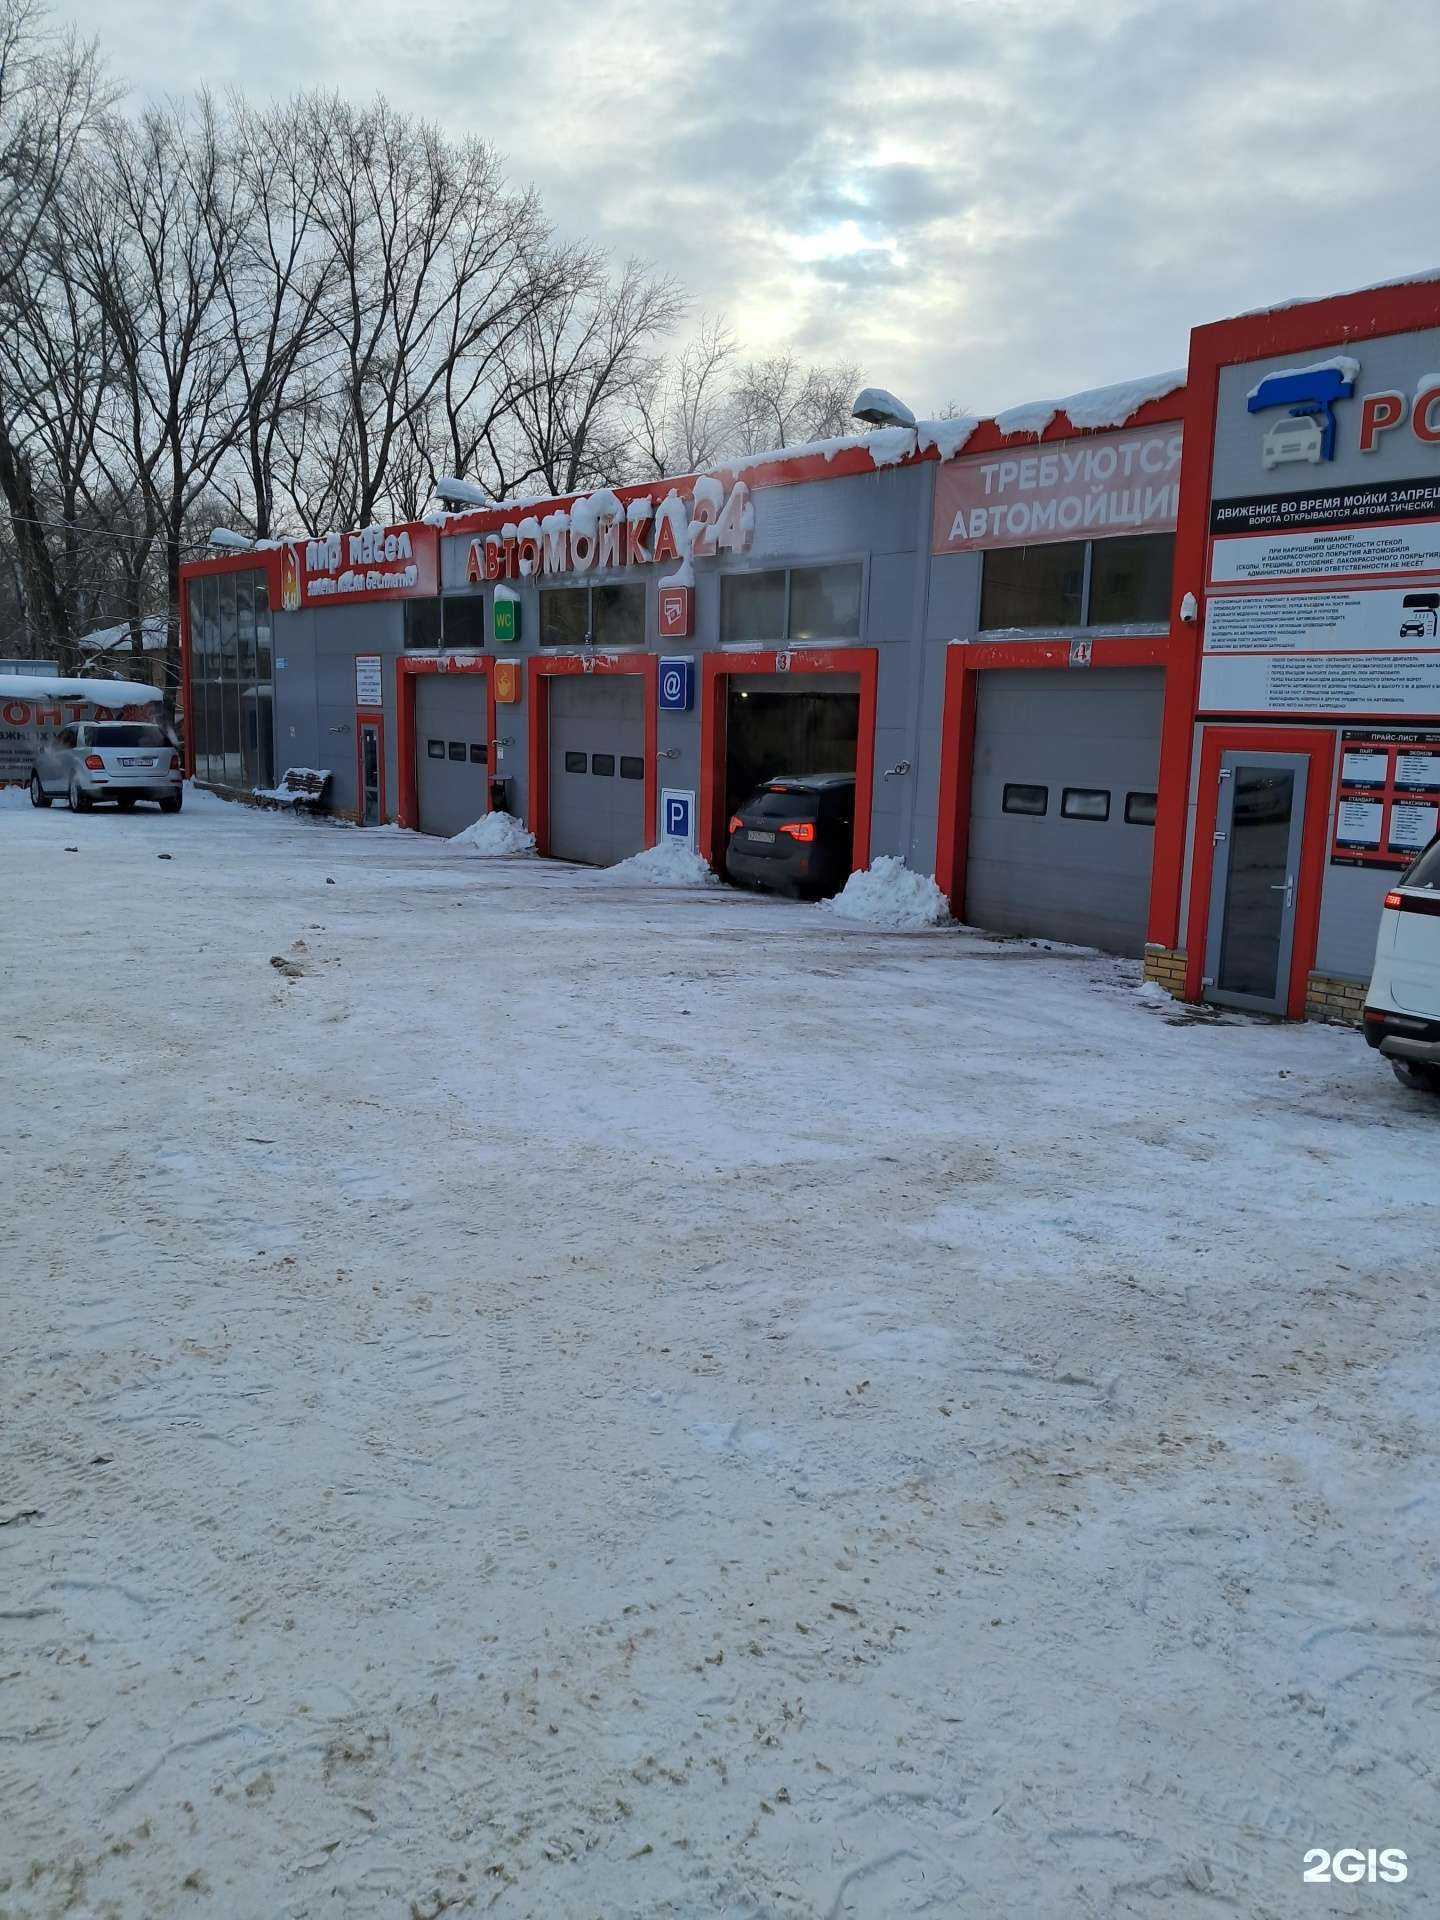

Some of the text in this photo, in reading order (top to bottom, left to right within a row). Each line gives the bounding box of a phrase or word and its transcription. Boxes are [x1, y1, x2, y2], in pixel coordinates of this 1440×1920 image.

[981, 439, 1183, 495] ТРЕБУЮТСЯ
[1217, 505, 1278, 520] ДВИЖЕНИЕ
[1281, 502, 1297, 513] ВО
[1301, 497, 1340, 511] ВРЕМЯ
[1344, 492, 1387, 507] МОЙКИ
[1249, 501, 1436, 525] ВОРОТА ОТКРЫВАЮТСЯ АВТОМАТИЧЕСКИ.
[466, 481, 754, 581] АВТОМОЙКА 24
[1314, 535, 1355, 543] ВНИМАНИЕ!
[1267, 553, 1324, 561] ЛАКОКРАСОЧНОГО
[1326, 549, 1361, 557] ПОКРЫТИЯ
[1363, 546, 1409, 555] АВТОМОБИЛЯ
[1283, 544, 1324, 553] НАРУШЕНИЯХ
[1327, 541, 1375, 550] ЦЕЛОСТНОСТИ
[1336, 555, 1398, 564] ЛАКОКРАСОЧНОГО
[1247, 568, 1300, 576] АДМИНИСТРАЦИЯ
[1324, 562, 1389, 572] ОТВЕТСТВЕННОСТИ
[497, 615, 512, 627] WC
[1074, 643, 1085, 663] 4
[779, 654, 787, 669] 3
[1371, 733, 1418, 742] ПРАЙС-ЛИСТ
[672, 803, 683, 832] P
